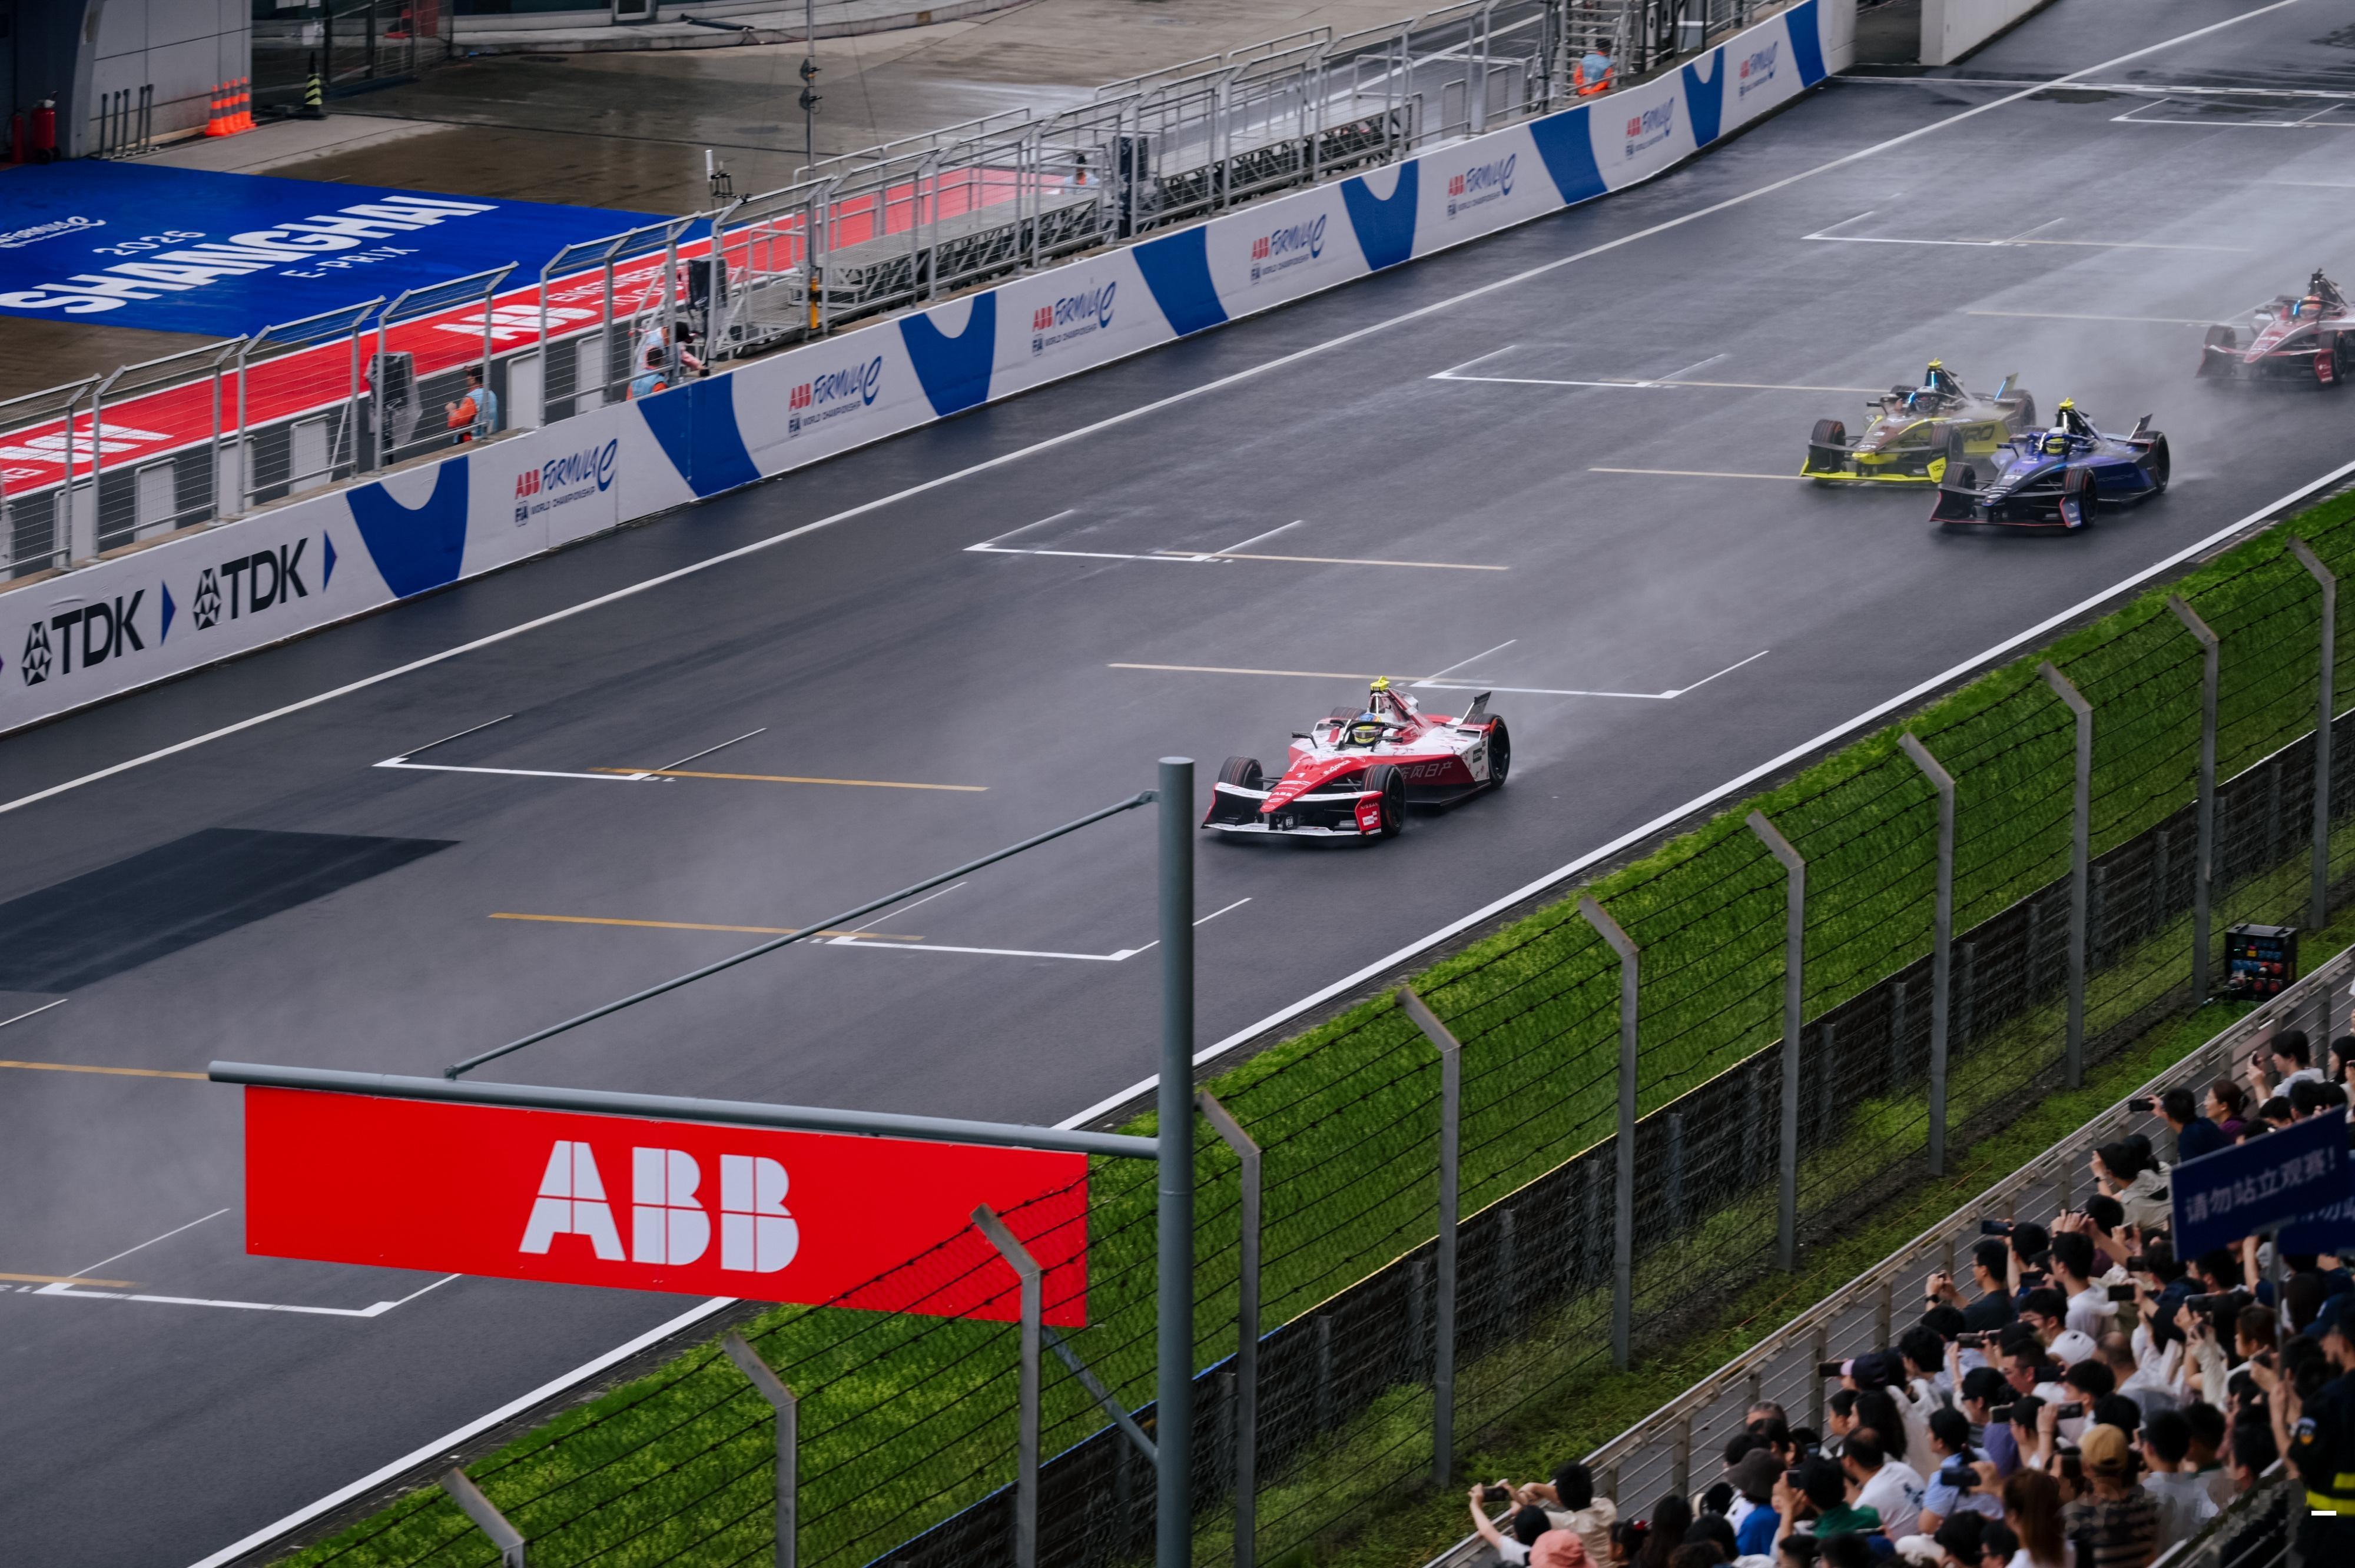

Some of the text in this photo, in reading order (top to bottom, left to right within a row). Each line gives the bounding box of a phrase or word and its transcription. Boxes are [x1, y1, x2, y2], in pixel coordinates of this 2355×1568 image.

[0, 195, 499, 313] SHANGHAI
[92, 230, 206, 255] 2026
[1251, 237, 1269, 261] ABB
[279, 246, 420, 278] E-PRIX
[432, 304, 598, 340] ABB
[1032, 305, 1052, 332] ABB
[788, 383, 811, 411] ABB
[515, 469, 540, 500] ABB
[221, 537, 309, 620] TDK
[51, 589, 146, 675] TDK
[518, 1140, 800, 1273] ABB
